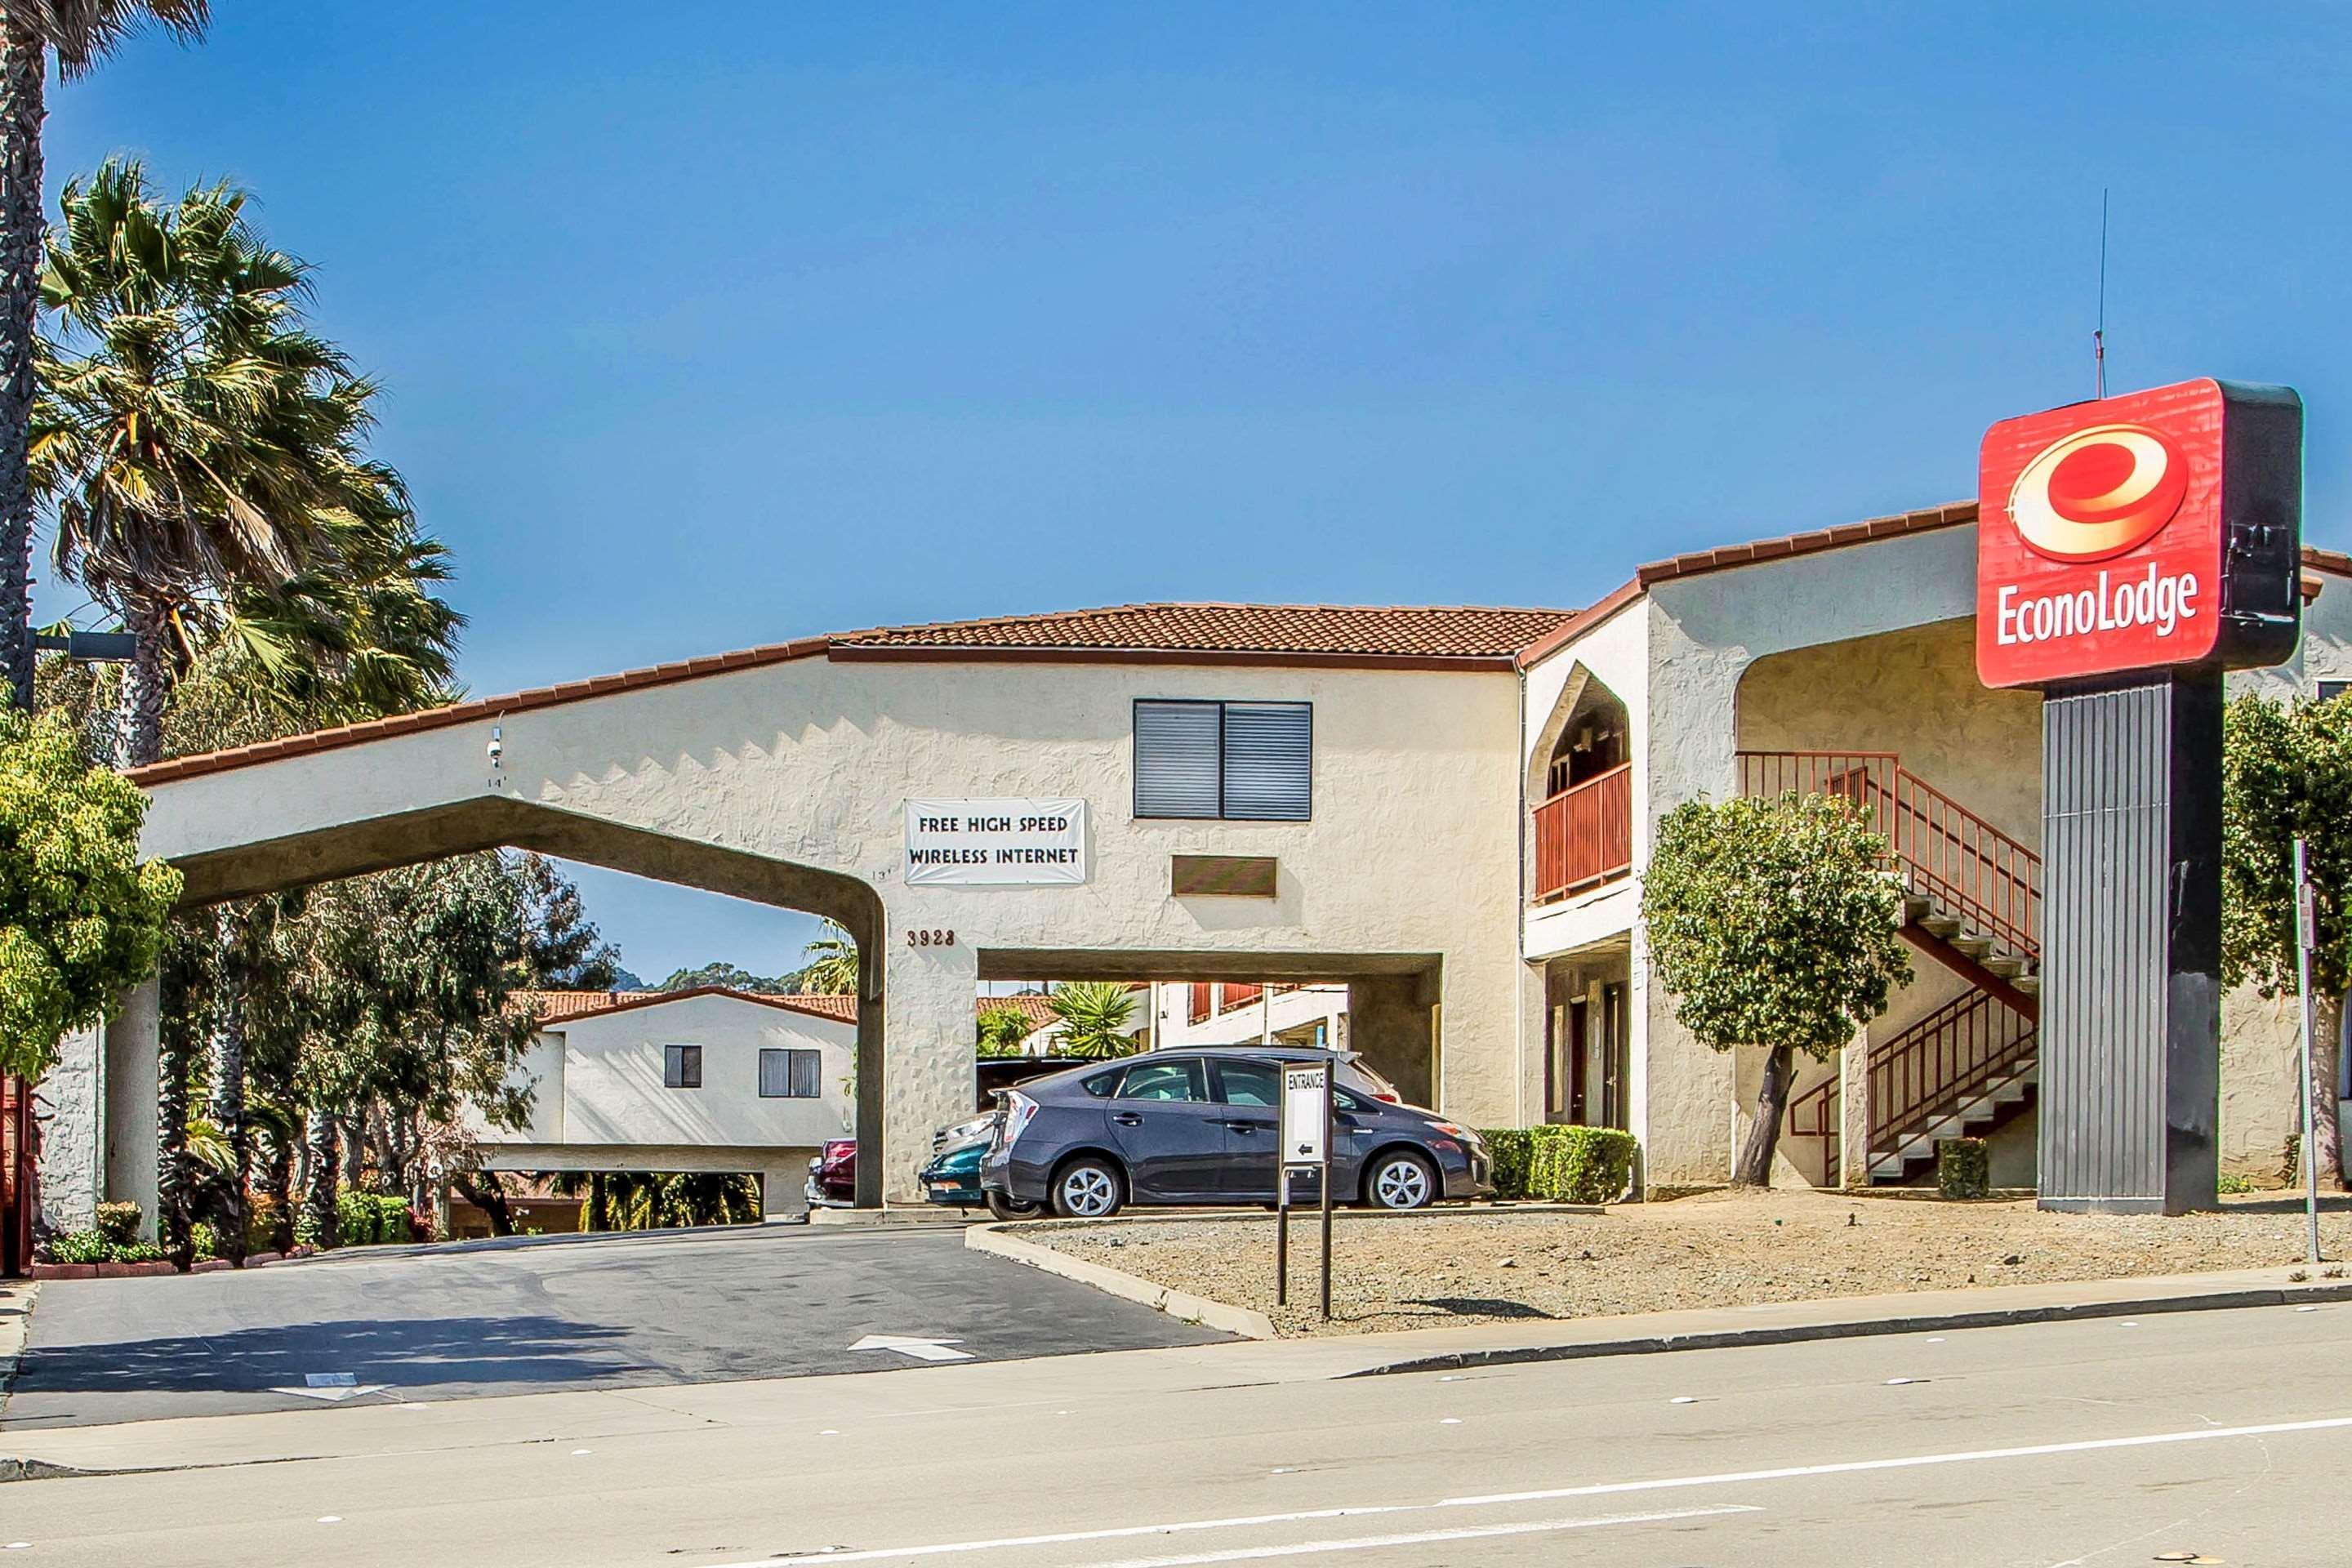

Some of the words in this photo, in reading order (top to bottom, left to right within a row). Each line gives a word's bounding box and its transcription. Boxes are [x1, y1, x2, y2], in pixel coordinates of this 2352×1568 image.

[1998, 562, 2198, 646] EconoLodge
[920, 817, 959, 832] FREE
[968, 817, 1011, 832] HIGH
[1019, 817, 1068, 832] SPEED
[910, 849, 987, 864] WIRELESS
[996, 849, 1078, 863] INTERNET
[907, 929, 955, 947] 3928
[1289, 1072, 1324, 1090] ENTRANCE
